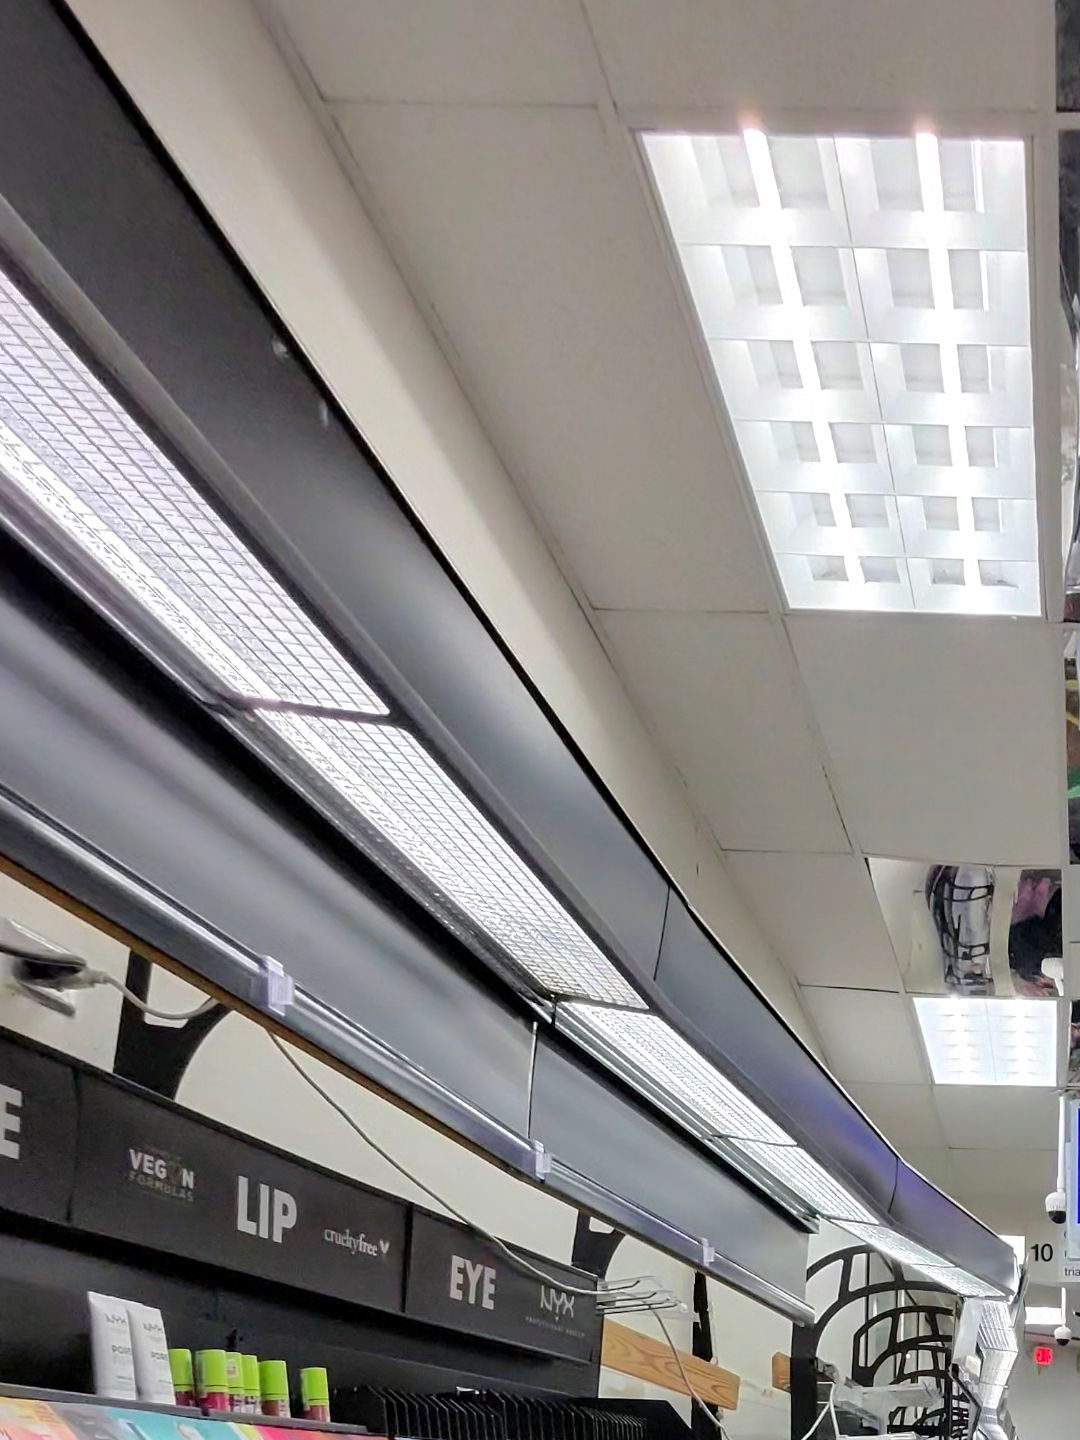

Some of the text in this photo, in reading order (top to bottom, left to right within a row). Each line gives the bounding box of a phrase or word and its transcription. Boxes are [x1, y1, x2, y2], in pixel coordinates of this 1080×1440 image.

[0, 1083, 22, 1160] E
[236, 1175, 297, 1244] LIP
[1030, 1243, 1053, 1262] 10
[450, 1254, 497, 1311] EYE
[540, 1284, 575, 1321] NYX
